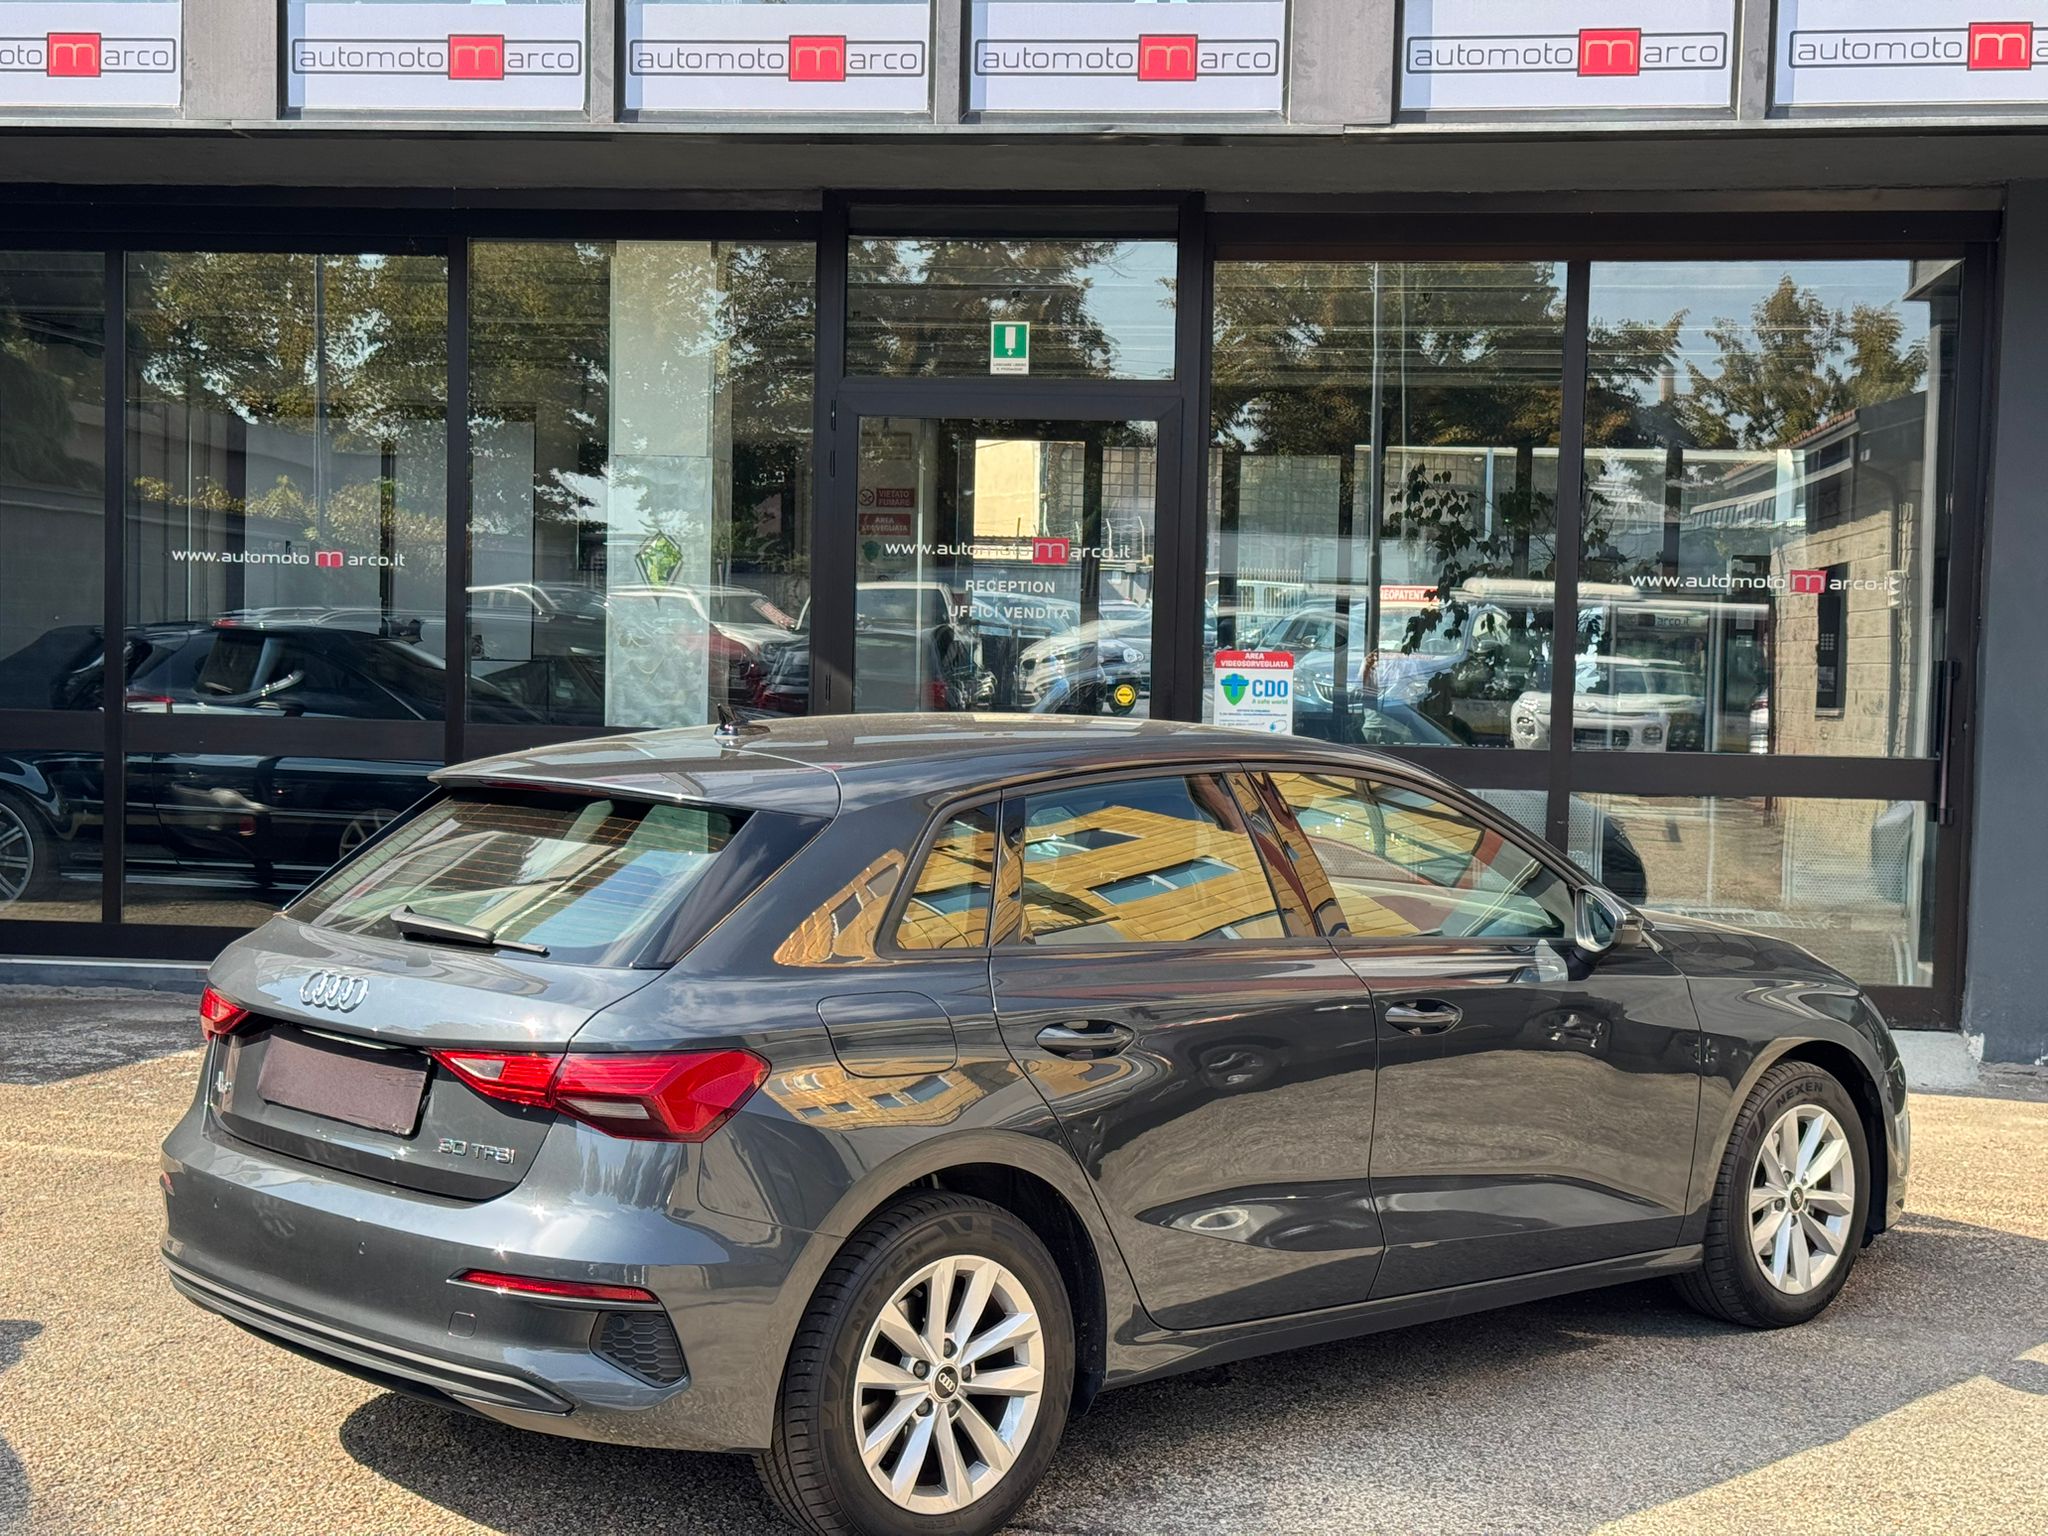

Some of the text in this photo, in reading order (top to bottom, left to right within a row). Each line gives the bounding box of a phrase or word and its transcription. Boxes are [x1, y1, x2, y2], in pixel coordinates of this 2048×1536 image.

[965, 579, 1056, 593] RECEPTION
[950, 605, 1071, 620] UFFICI VENDITA
[1244, 652, 1265, 660] AREA
[1220, 660, 1289, 668] VIDEOSORVEGLIATA
[1252, 679, 1289, 698] CDO
[1775, 1082, 1824, 1109] NEXEN
[852, 1240, 924, 1333] NEXEN
